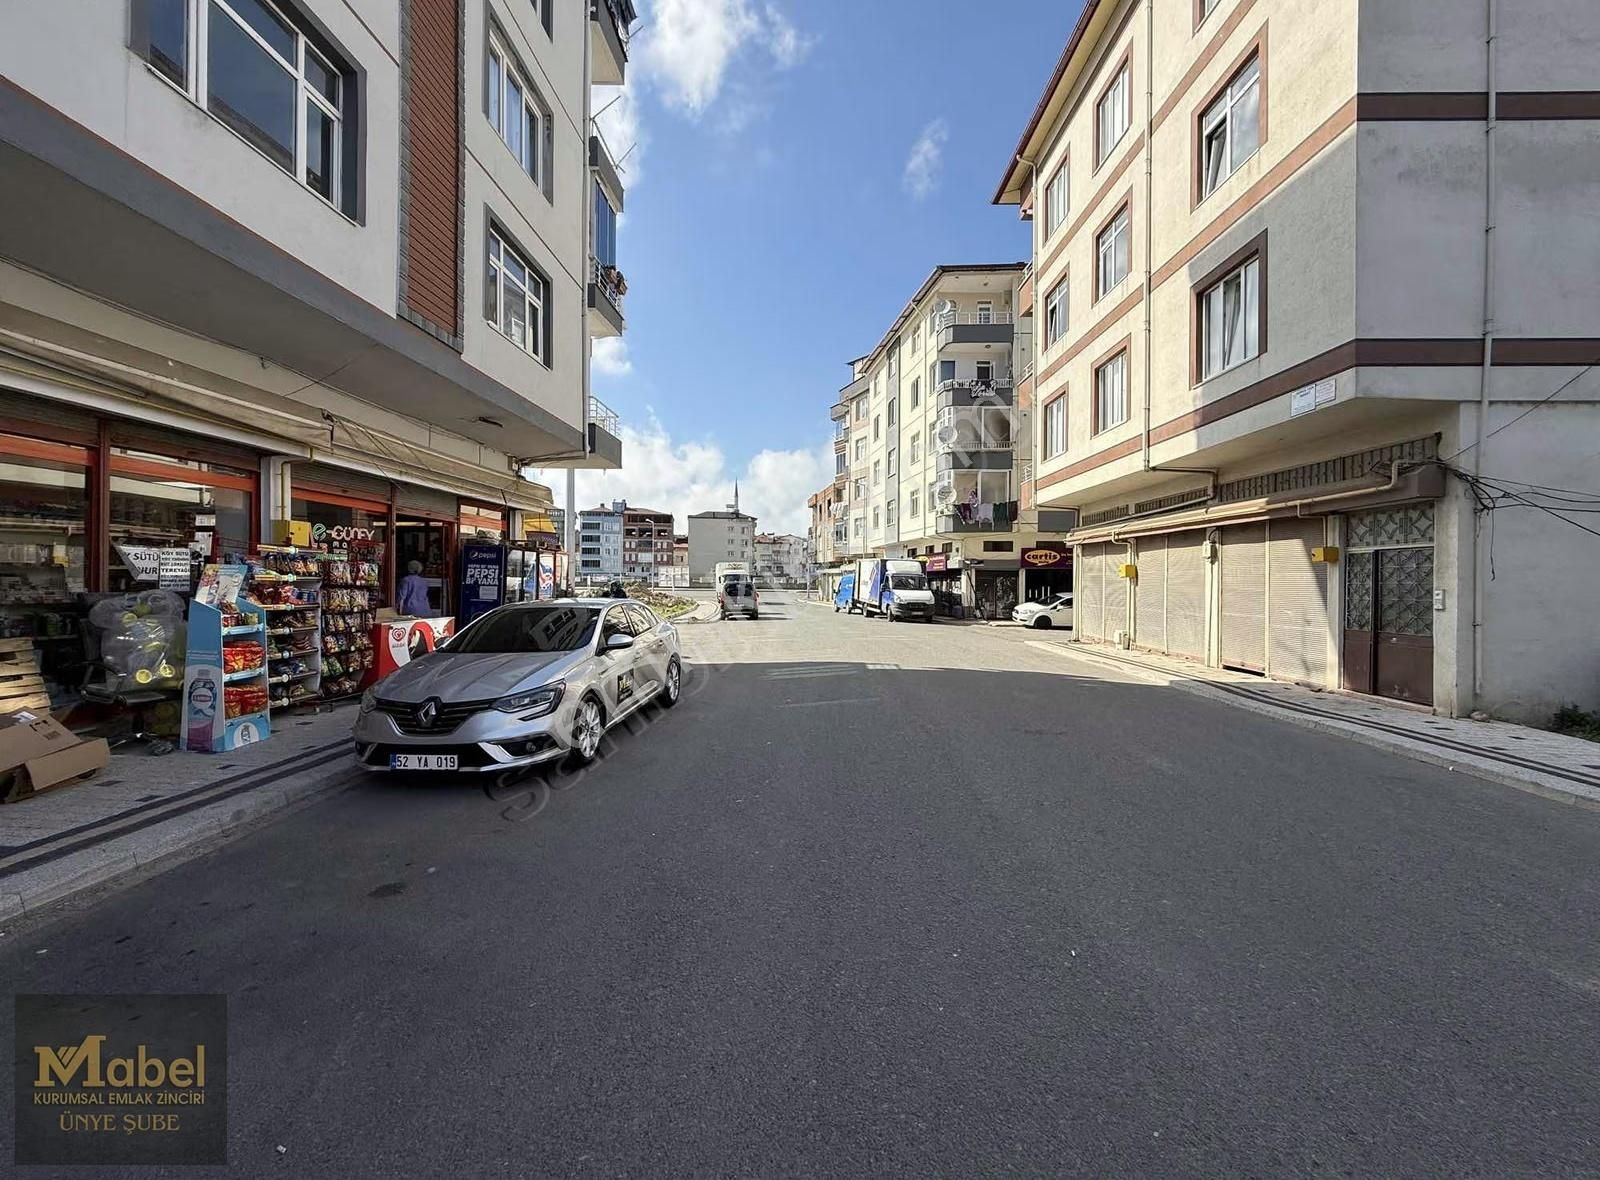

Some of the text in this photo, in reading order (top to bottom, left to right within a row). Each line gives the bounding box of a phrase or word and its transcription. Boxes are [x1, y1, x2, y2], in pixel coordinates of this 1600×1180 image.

[133, 551, 159, 561] SÜTÜ
[396, 756, 455, 768] 52 YA 019
